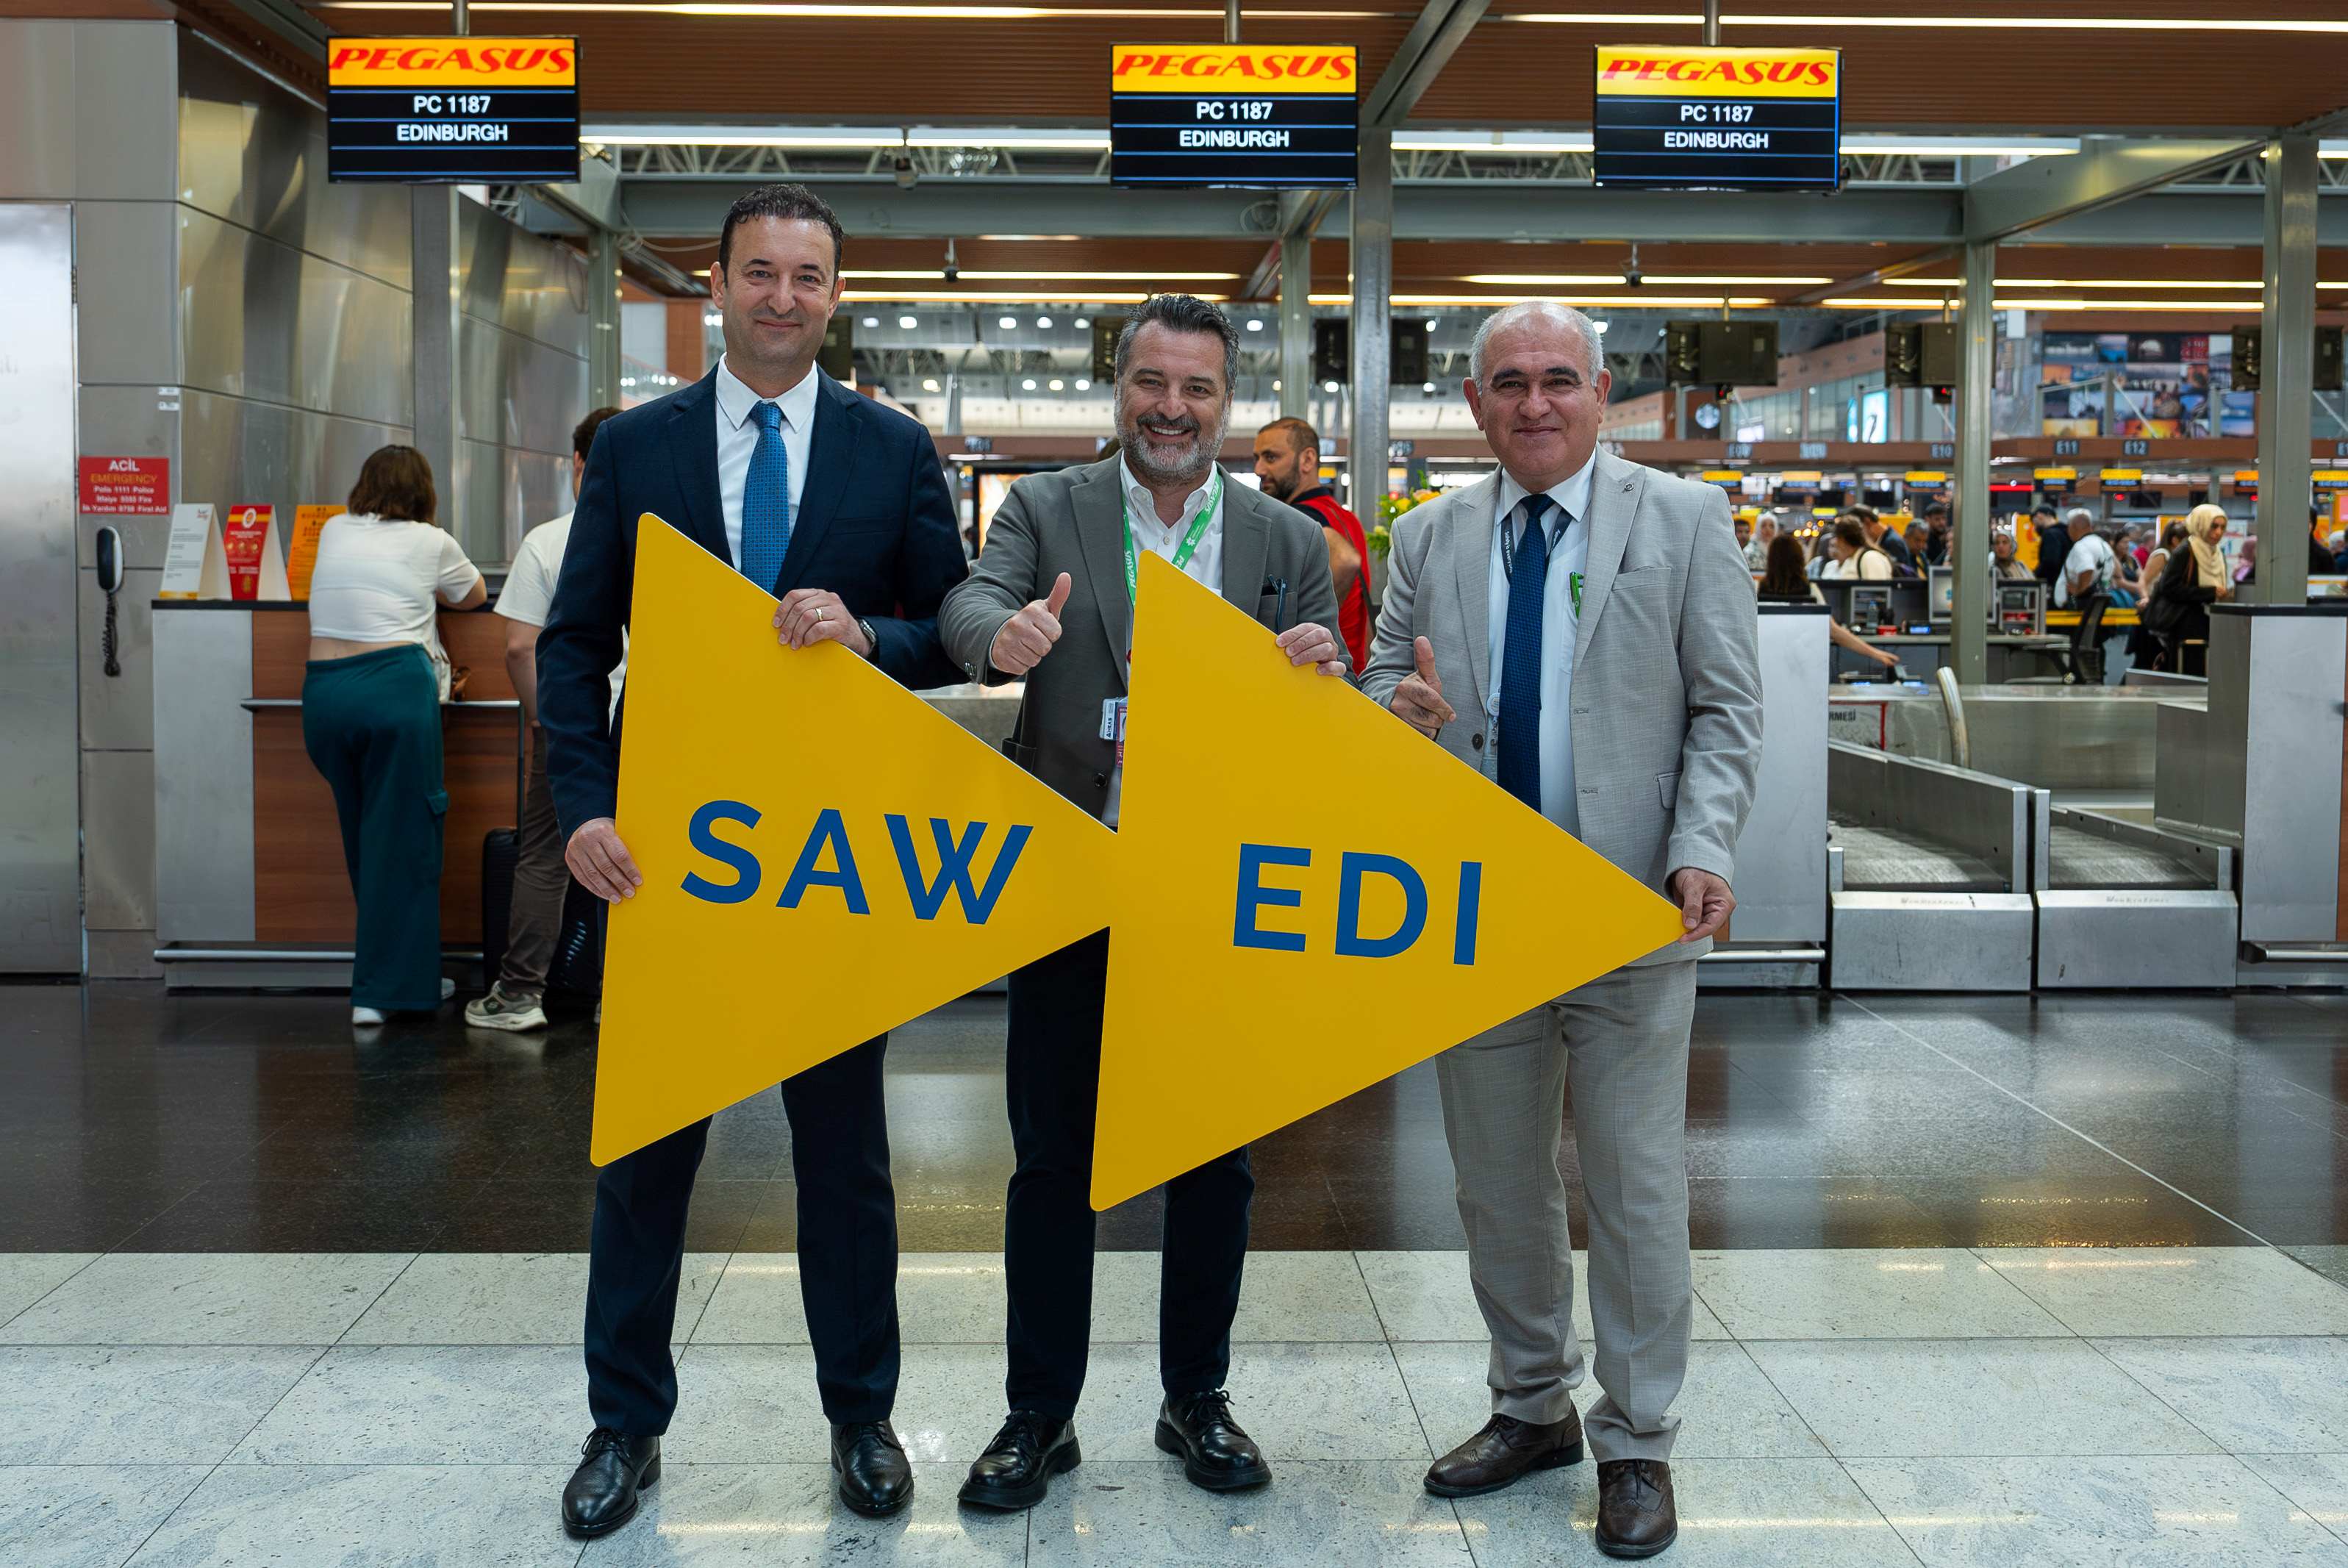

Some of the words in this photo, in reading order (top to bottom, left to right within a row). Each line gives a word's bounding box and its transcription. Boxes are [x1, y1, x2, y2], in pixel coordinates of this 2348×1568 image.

[329, 48, 575, 73] PEGASUS
[1113, 54, 1356, 80] PEGASUS
[1602, 60, 1834, 85] PEGASUS
[413, 96, 441, 113] PC
[447, 96, 491, 113] 1187
[1196, 101, 1224, 120] PC
[1229, 101, 1273, 120] 1187
[1681, 105, 1707, 122] PC
[1712, 105, 1754, 123] 1187
[397, 124, 509, 141] EDINBURGH
[1179, 130, 1290, 147] EDINBURGH
[1664, 131, 1769, 148] EDINBURGH
[1932, 444, 1953, 457] E10
[2057, 440, 2077, 454] E11
[2125, 440, 2146, 455] E12
[90, 473, 159, 483] EMERGENCY
[133, 486, 154, 494] Police
[155, 505, 167, 513] Aid
[1124, 550, 1137, 589] PEGASUS
[1829, 709, 1856, 721] RMESİ
[680, 799, 1034, 925] SAW
[1232, 843, 1483, 966] EDI
